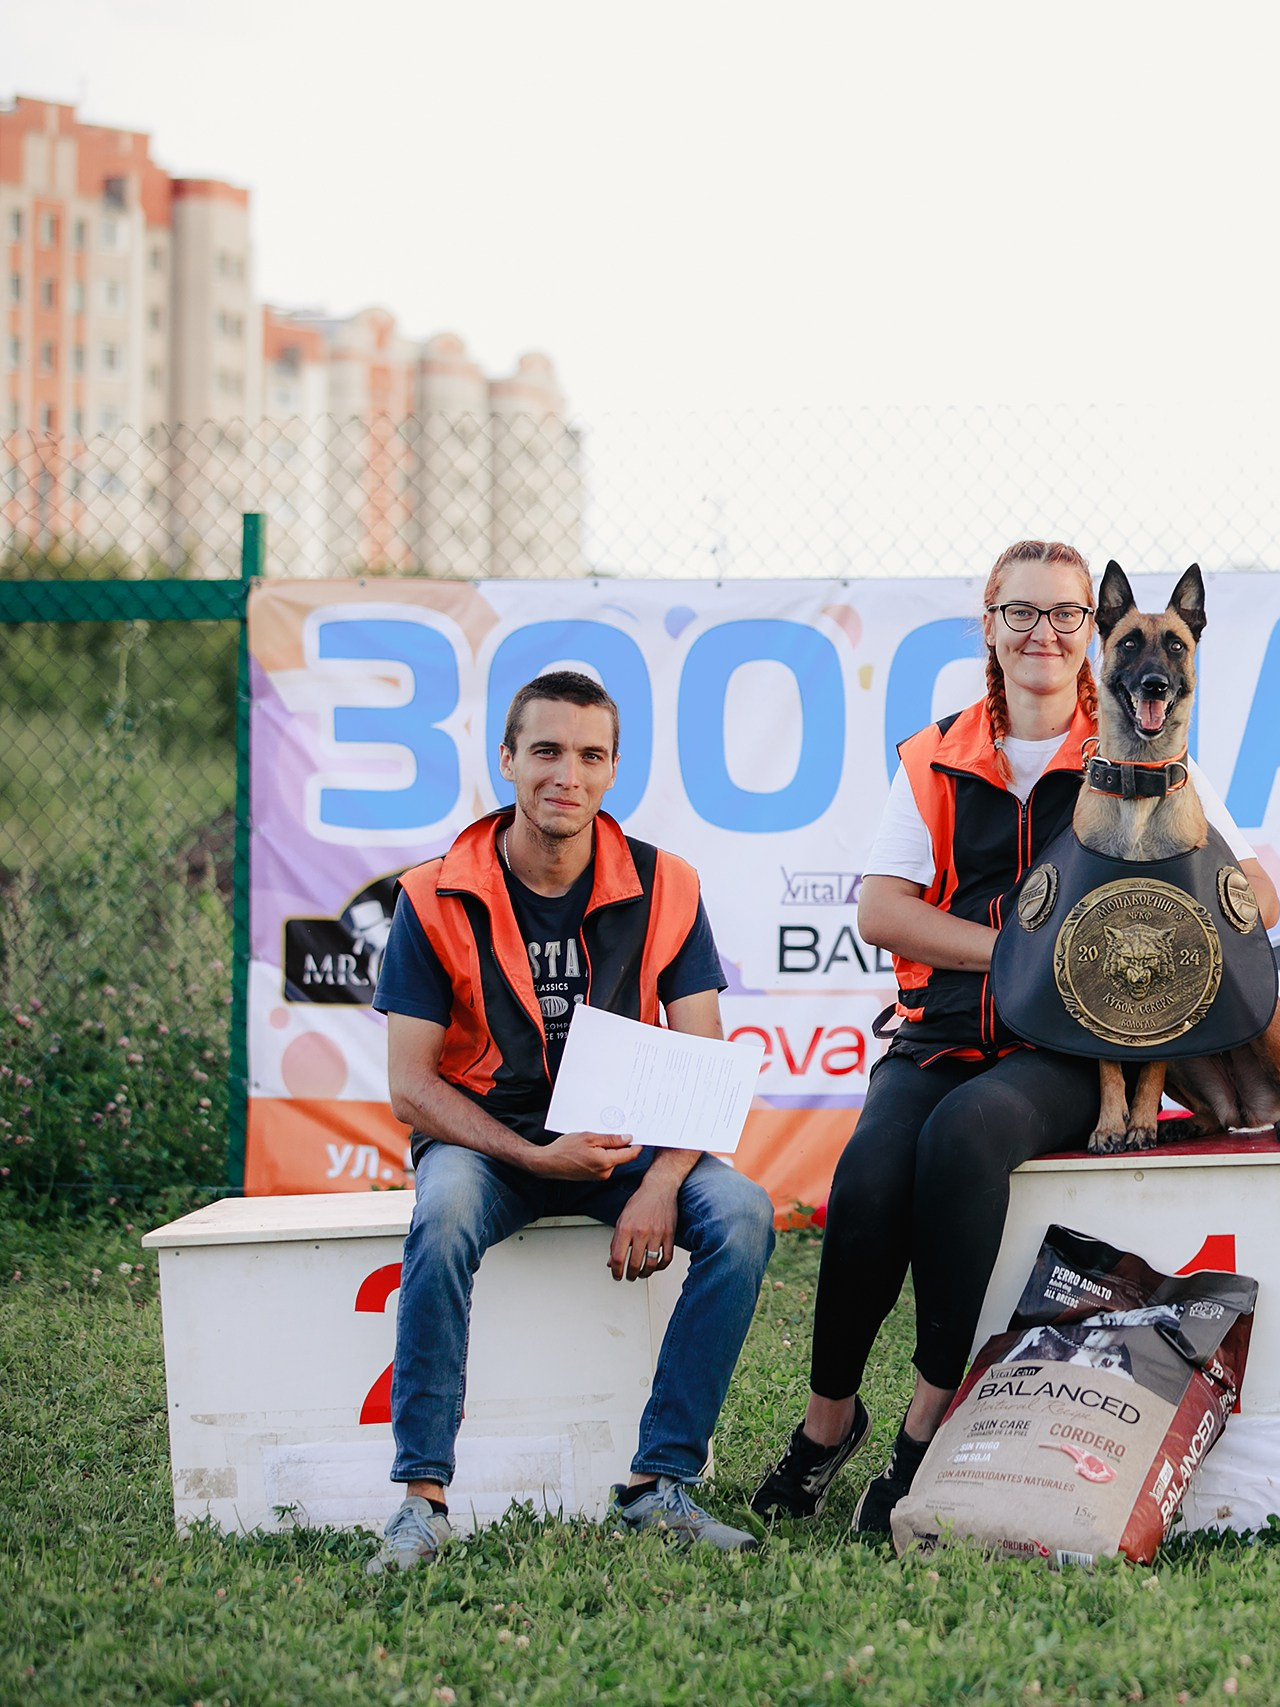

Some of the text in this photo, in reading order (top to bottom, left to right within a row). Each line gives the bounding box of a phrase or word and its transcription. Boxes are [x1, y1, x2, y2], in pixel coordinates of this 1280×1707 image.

[528, 938, 588, 979] STA
[778, 925, 894, 974] BAL
[1078, 944, 1099, 962] 20
[1180, 949, 1201, 966] 24
[544, 1022, 569, 1030] COMP
[1051, 1265, 1113, 1301] PERRO ADULTO
[1043, 1289, 1080, 1309] ALL BREEDS
[978, 1380, 1141, 1424] BALANCED
[971, 1419, 1032, 1432] SKIN CARE
[959, 1441, 1000, 1451] SIN TRIGO
[1049, 1422, 1126, 1458] CORDERO
[953, 1453, 992, 1463] SIN SOJA
[1160, 1409, 1215, 1526] BALANCED
[937, 1469, 1076, 1492] CON ANTIOXIDANTES NATURALES
